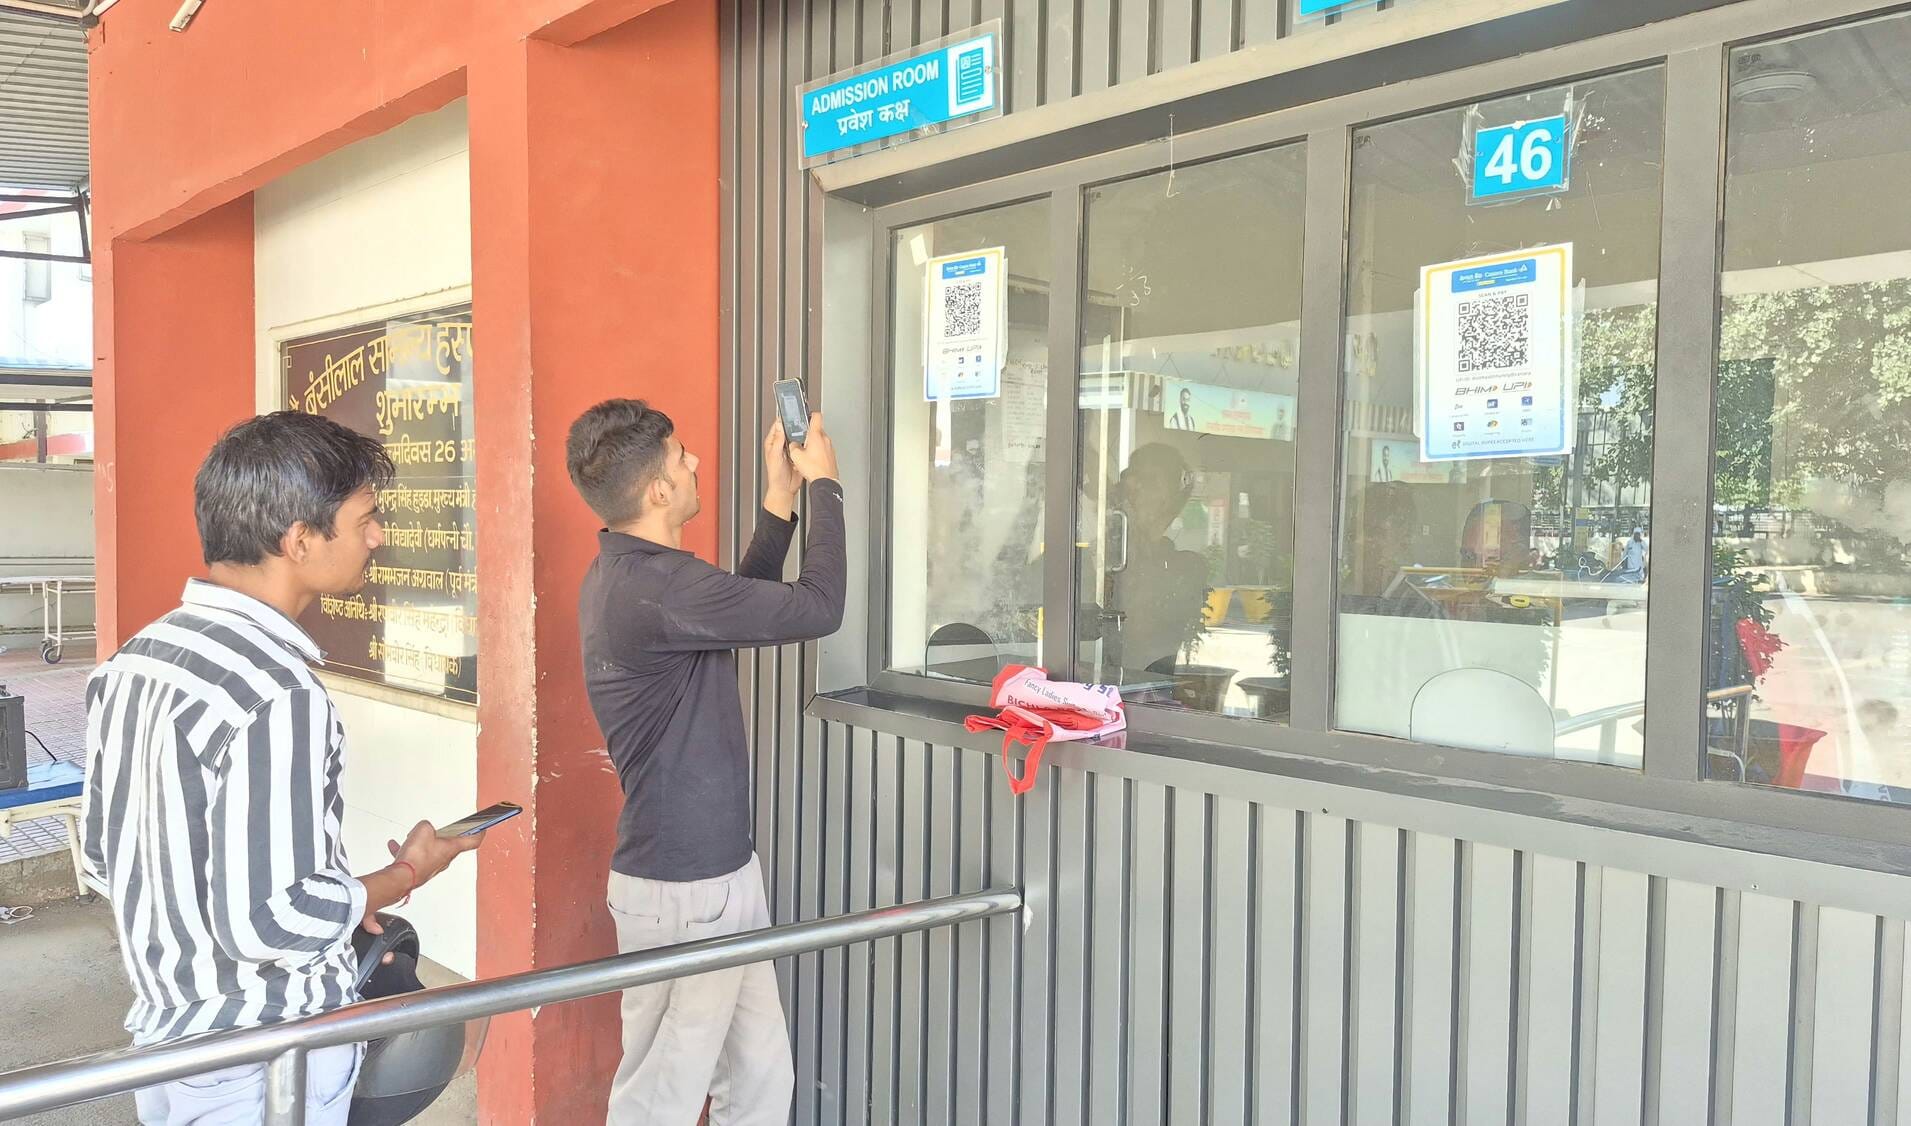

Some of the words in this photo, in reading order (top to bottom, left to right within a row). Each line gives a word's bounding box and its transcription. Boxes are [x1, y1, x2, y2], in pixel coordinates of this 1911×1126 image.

[811, 76, 889, 116] ADMISSION
[892, 59, 940, 91] ROOM
[836, 109, 874, 136] प्रवेश
[877, 99, 911, 123] कक्ष
[1484, 128, 1553, 185] 46
[1455, 385, 1492, 396] BHIM
[434, 440, 456, 463] 26
[1024, 678, 1041, 695] Fancy
[1041, 686, 1061, 705] Ladies
